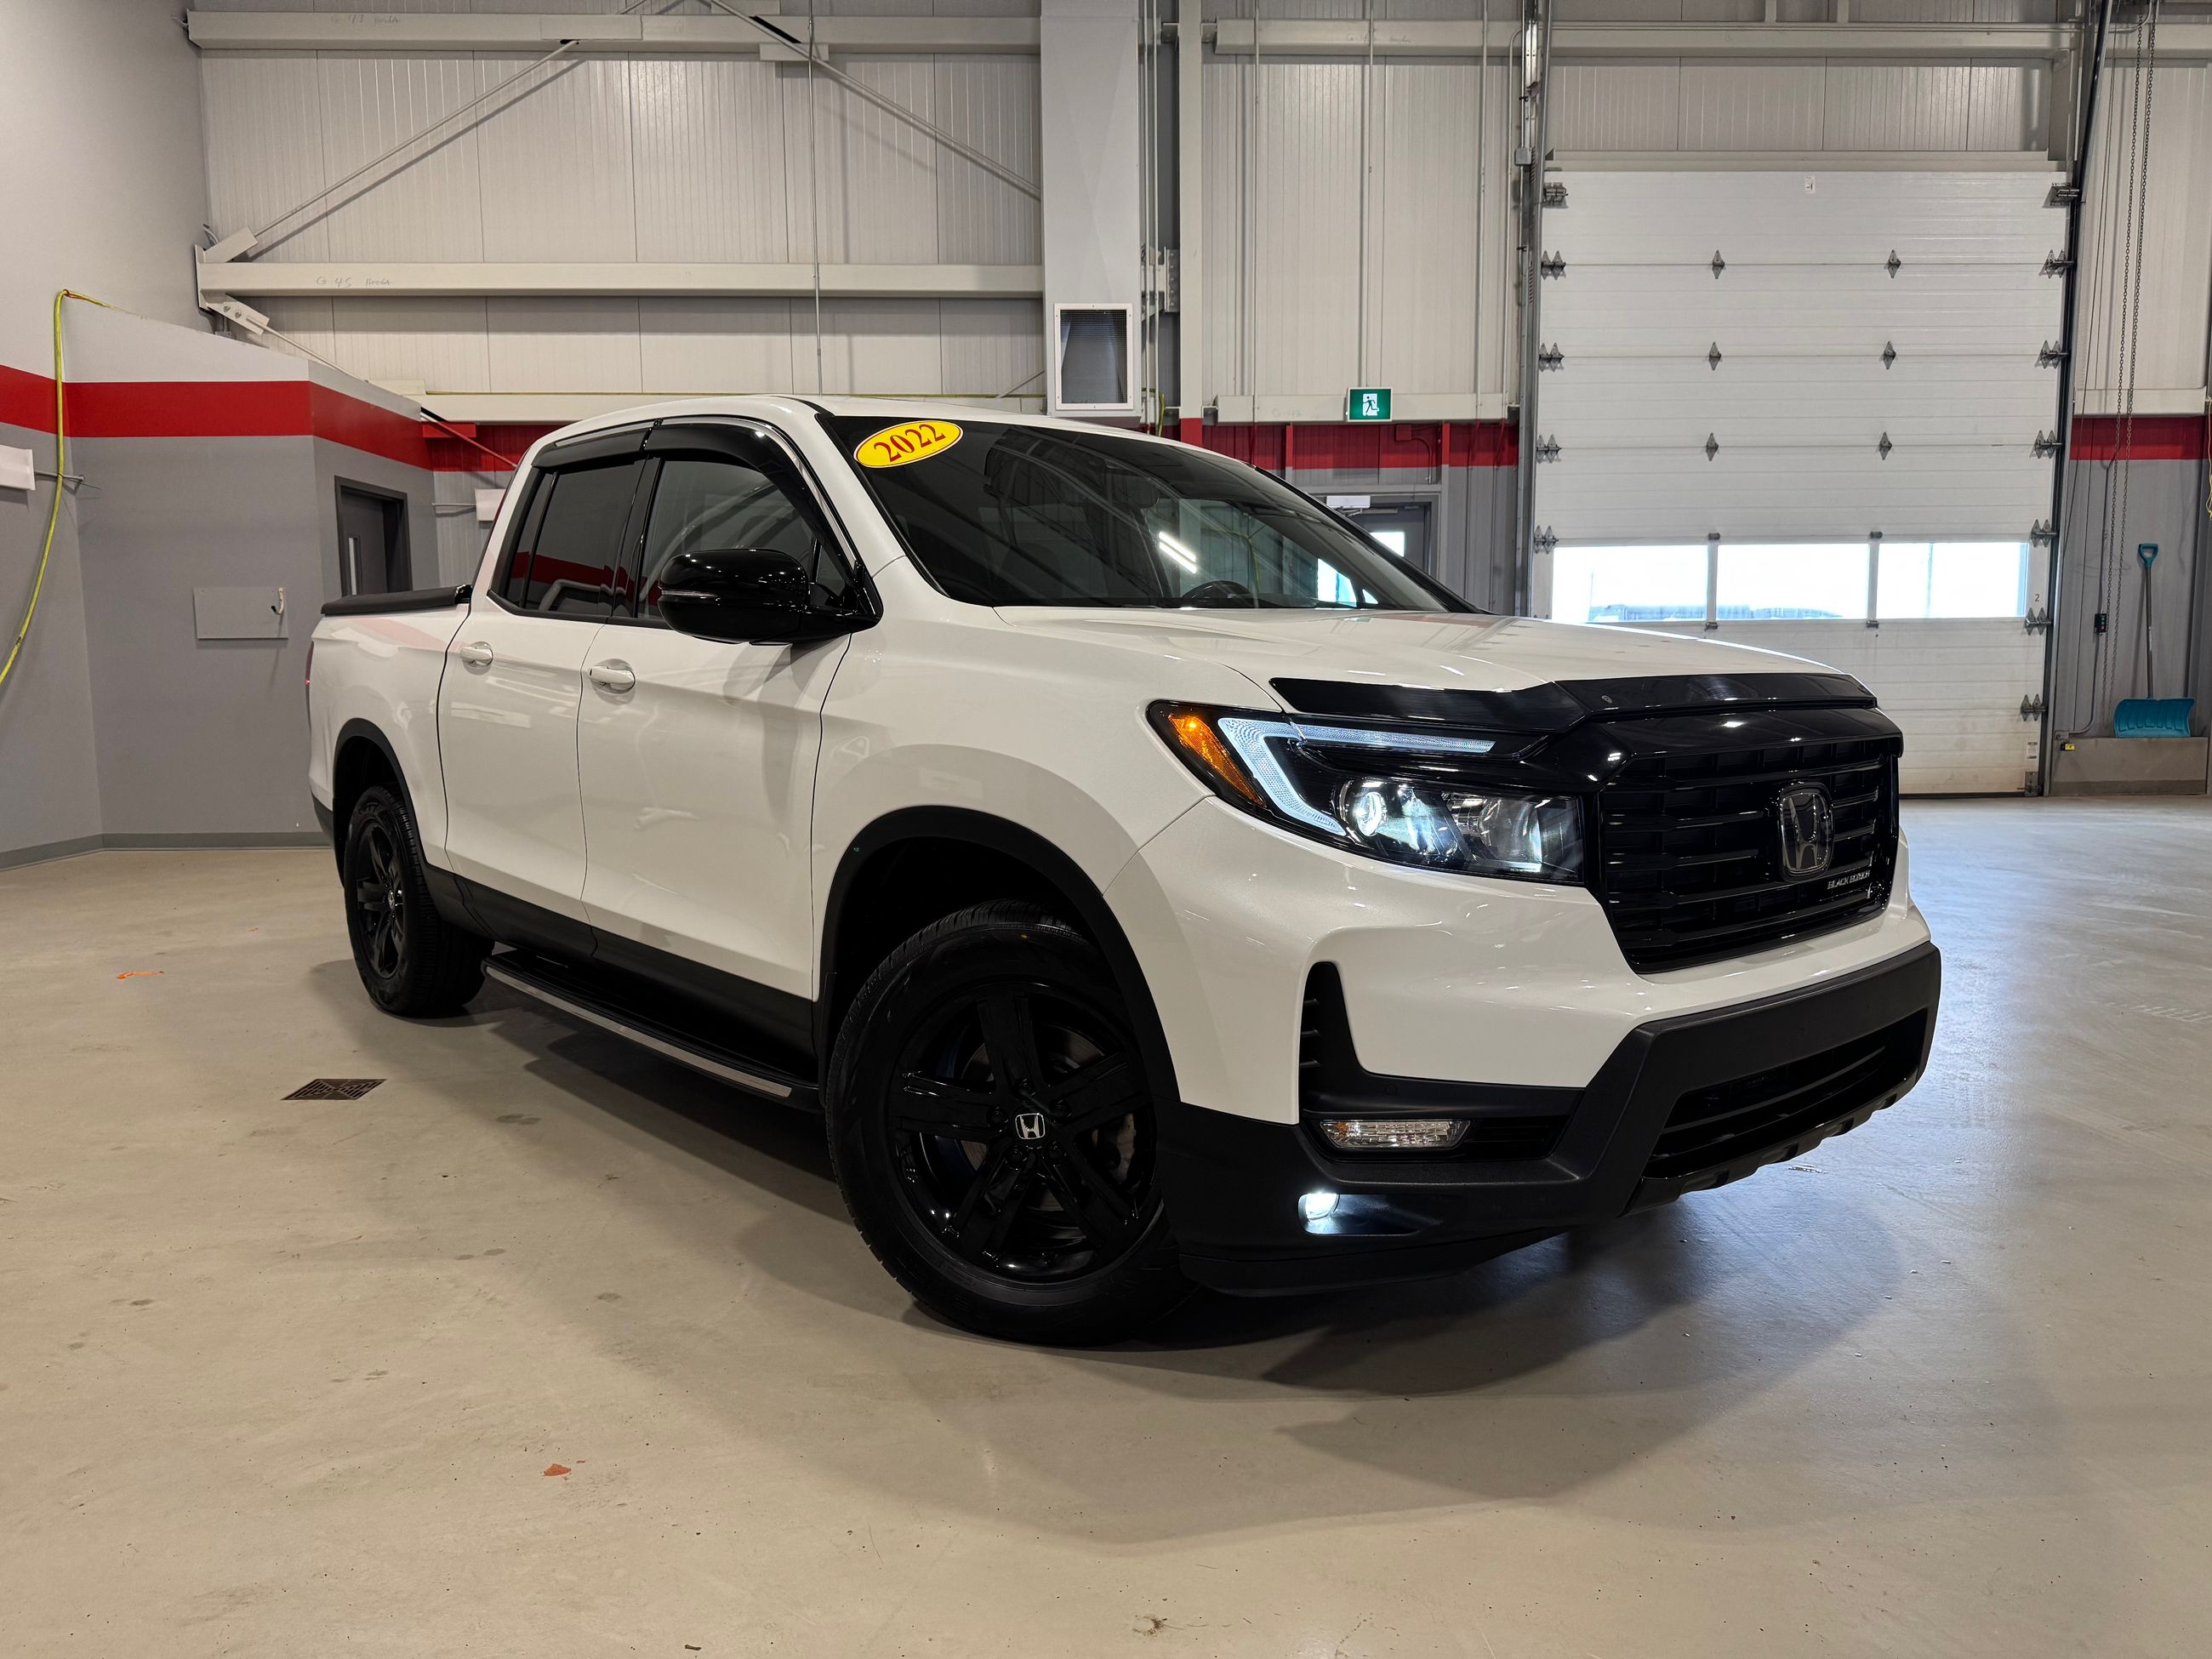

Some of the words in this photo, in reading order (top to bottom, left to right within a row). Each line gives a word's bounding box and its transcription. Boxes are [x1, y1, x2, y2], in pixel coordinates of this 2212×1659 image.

[873, 424, 947, 462] 2022
[2034, 593, 2040, 602] 2
[1827, 876, 1849, 890] BLACK
